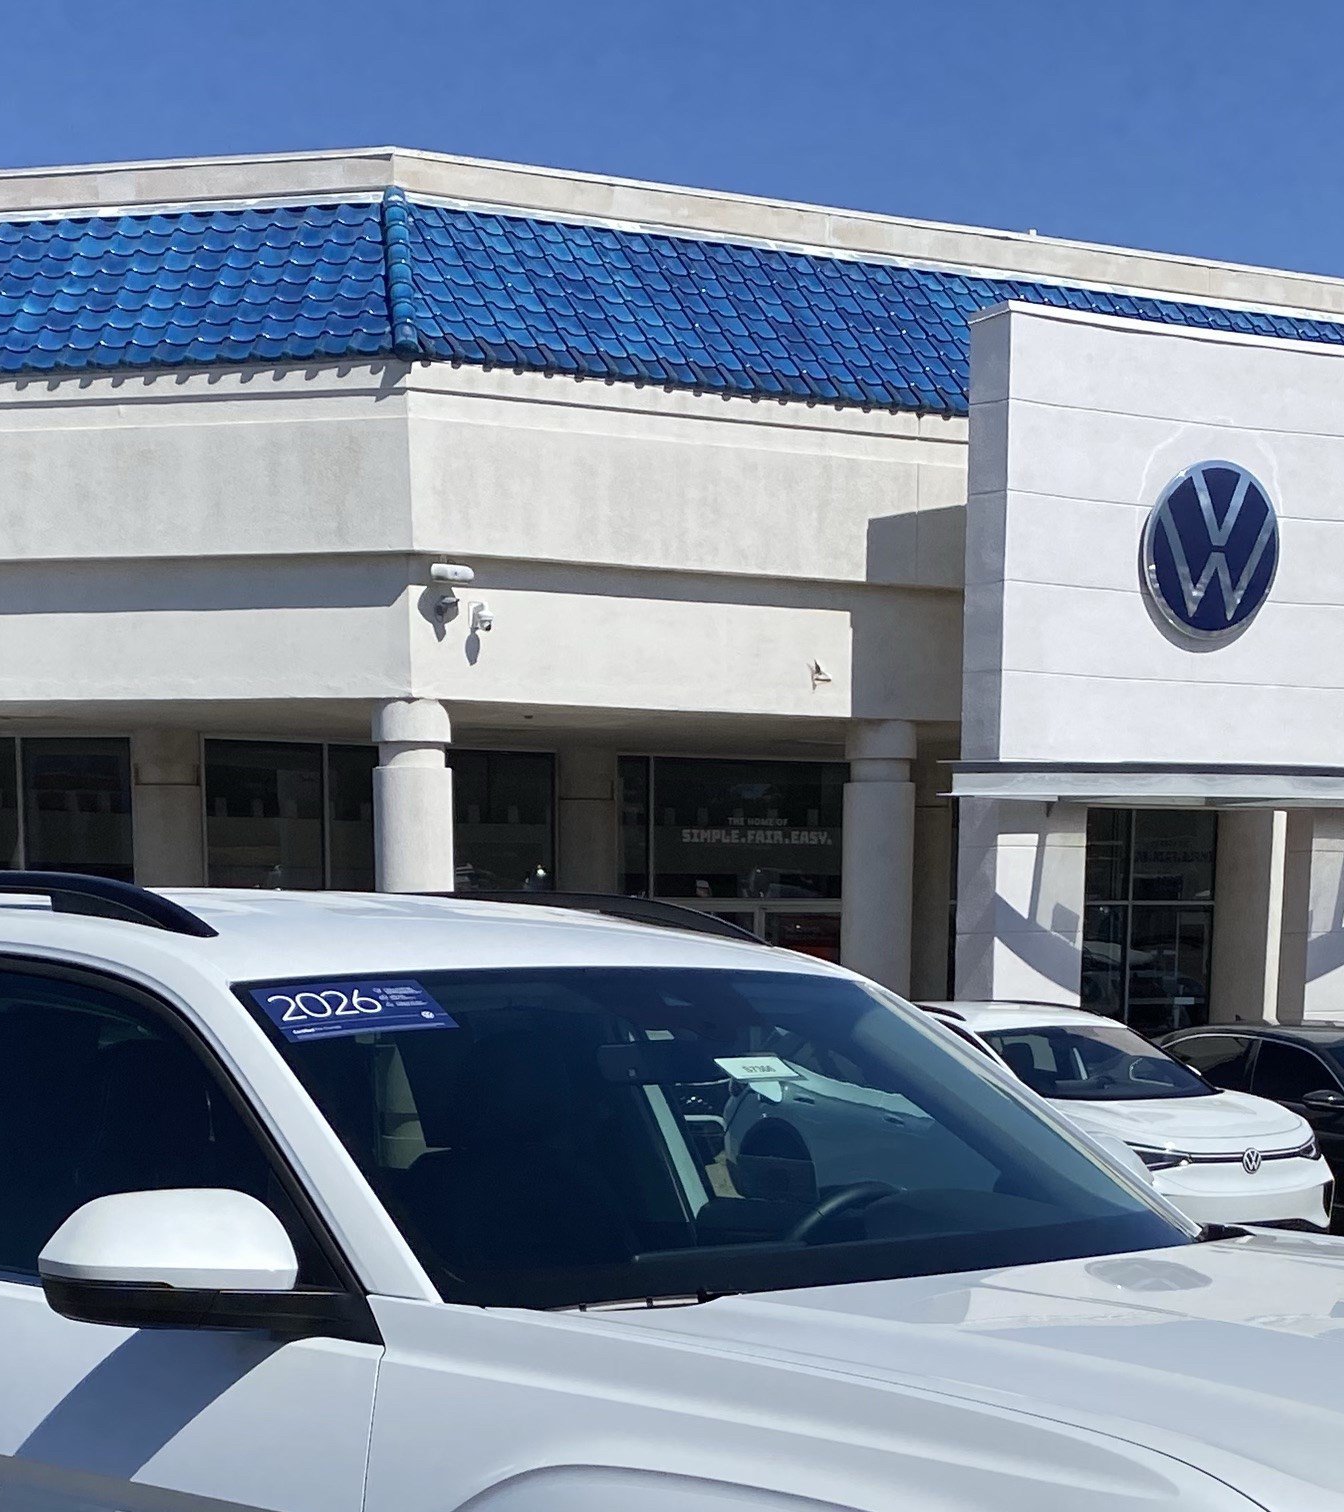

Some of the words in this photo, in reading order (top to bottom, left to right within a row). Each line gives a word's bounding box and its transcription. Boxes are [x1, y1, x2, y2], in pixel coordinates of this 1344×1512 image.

[1147, 463, 1277, 634] VW
[727, 817, 744, 826] THE
[747, 817, 773, 826] HOME
[775, 818, 788, 826] OF
[267, 989, 382, 1021] 2026
[1243, 1148, 1261, 1174] VW
